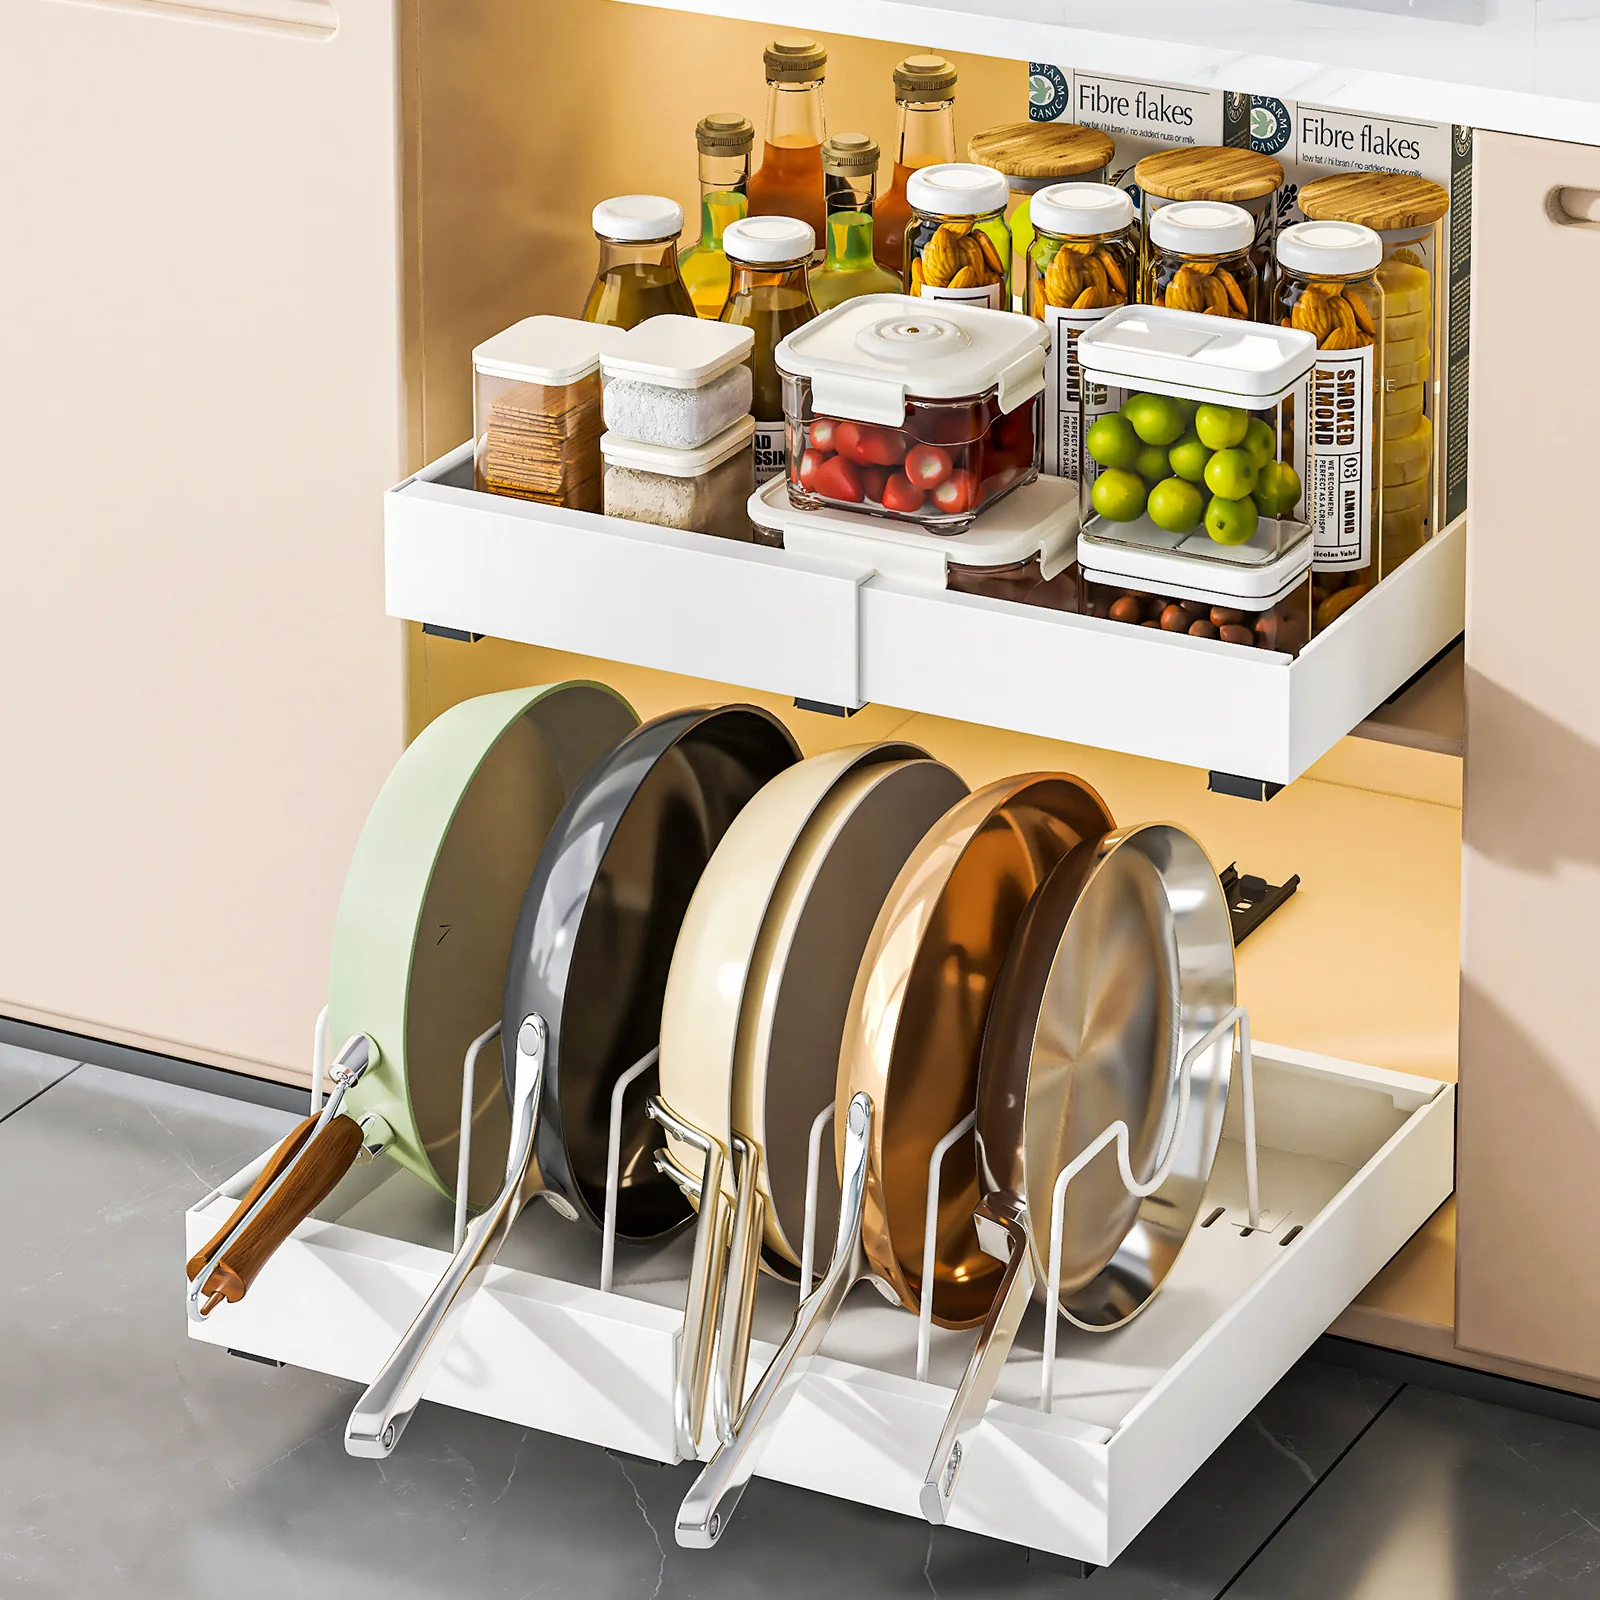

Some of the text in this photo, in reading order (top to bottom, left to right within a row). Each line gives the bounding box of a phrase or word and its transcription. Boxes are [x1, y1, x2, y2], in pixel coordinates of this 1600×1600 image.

[1043, 64, 1065, 96] FARM
[1030, 99, 1063, 119] GANIC
[1079, 84, 1130, 117] Fibre
[1135, 91, 1193, 126] flakes
[1265, 97, 1288, 129] FARM
[1110, 124, 1125, 133] bran
[1130, 128, 1138, 136] no
[1139, 129, 1160, 139] added
[1182, 135, 1196, 145] milk
[1251, 132, 1285, 152] GANIC
[1302, 117, 1354, 150] Fibre
[1360, 124, 1420, 160] flakes
[1302, 153, 1315, 162] low
[1315, 154, 1324, 164] fat
[1328, 157, 1334, 166] hi
[1335, 158, 1350, 168] bran
[1355, 162, 1363, 170] no
[1364, 163, 1385, 173] added
[1315, 369, 1335, 445] ALMOND
[1336, 369, 1356, 446] SMOKED
[1063, 448, 1069, 456] IN
[1071, 448, 1078, 458] AS
[1327, 459, 1334, 470] WE
[1344, 457, 1358, 479] 03
[1319, 491, 1326, 502] AS
[1344, 490, 1355, 534] ALMOND
